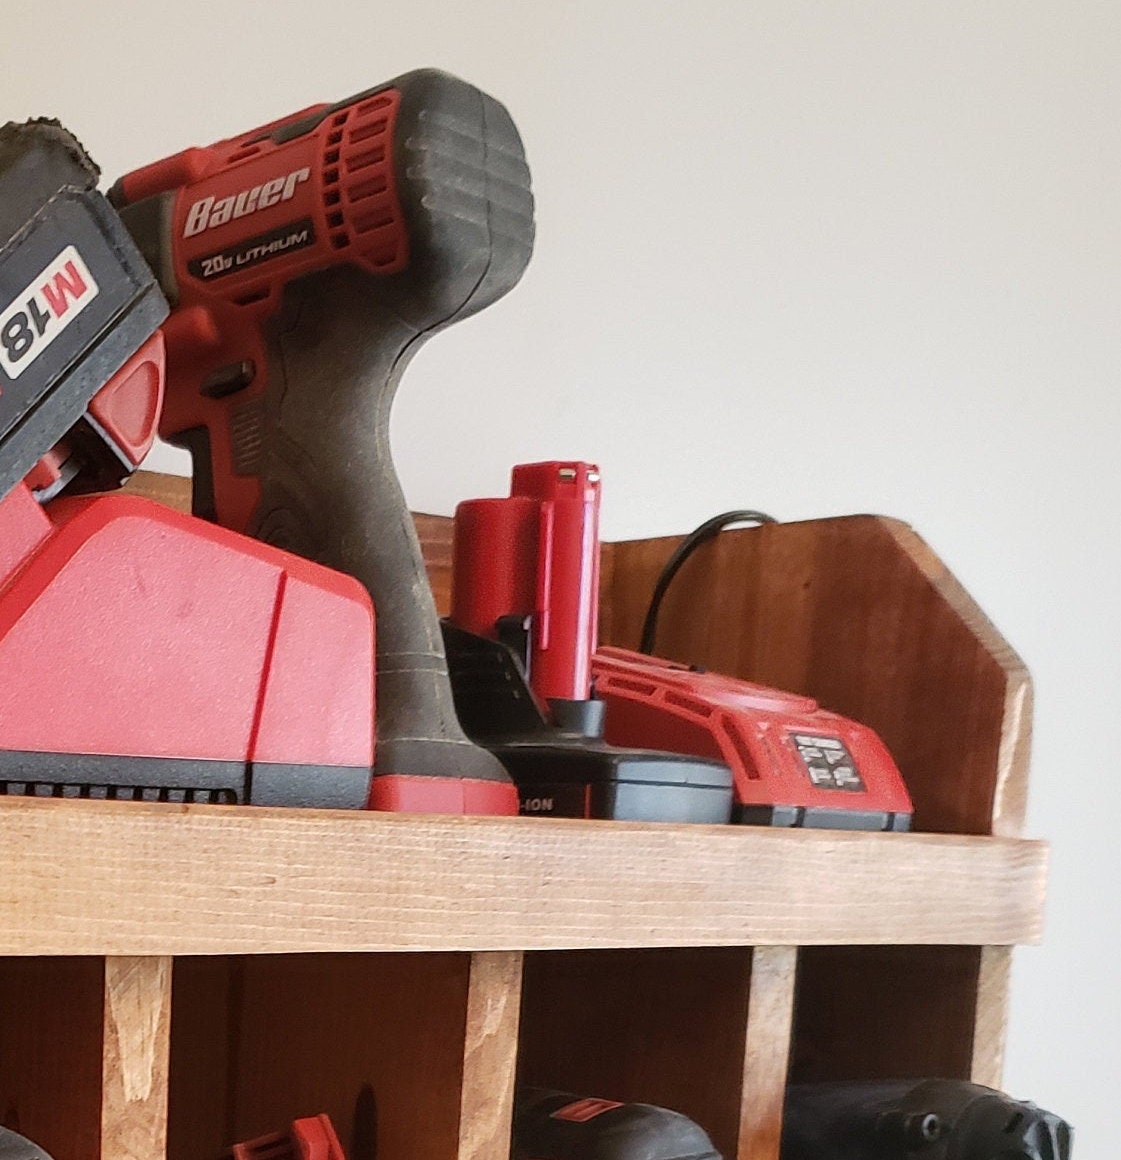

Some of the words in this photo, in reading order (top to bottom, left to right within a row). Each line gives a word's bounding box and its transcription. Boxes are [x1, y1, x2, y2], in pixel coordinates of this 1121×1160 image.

[183, 168, 310, 238] Bauer
[235, 229, 308, 266] LITHIUM
[0, 259, 87, 363] M18
[521, 797, 553, 811] -ION
